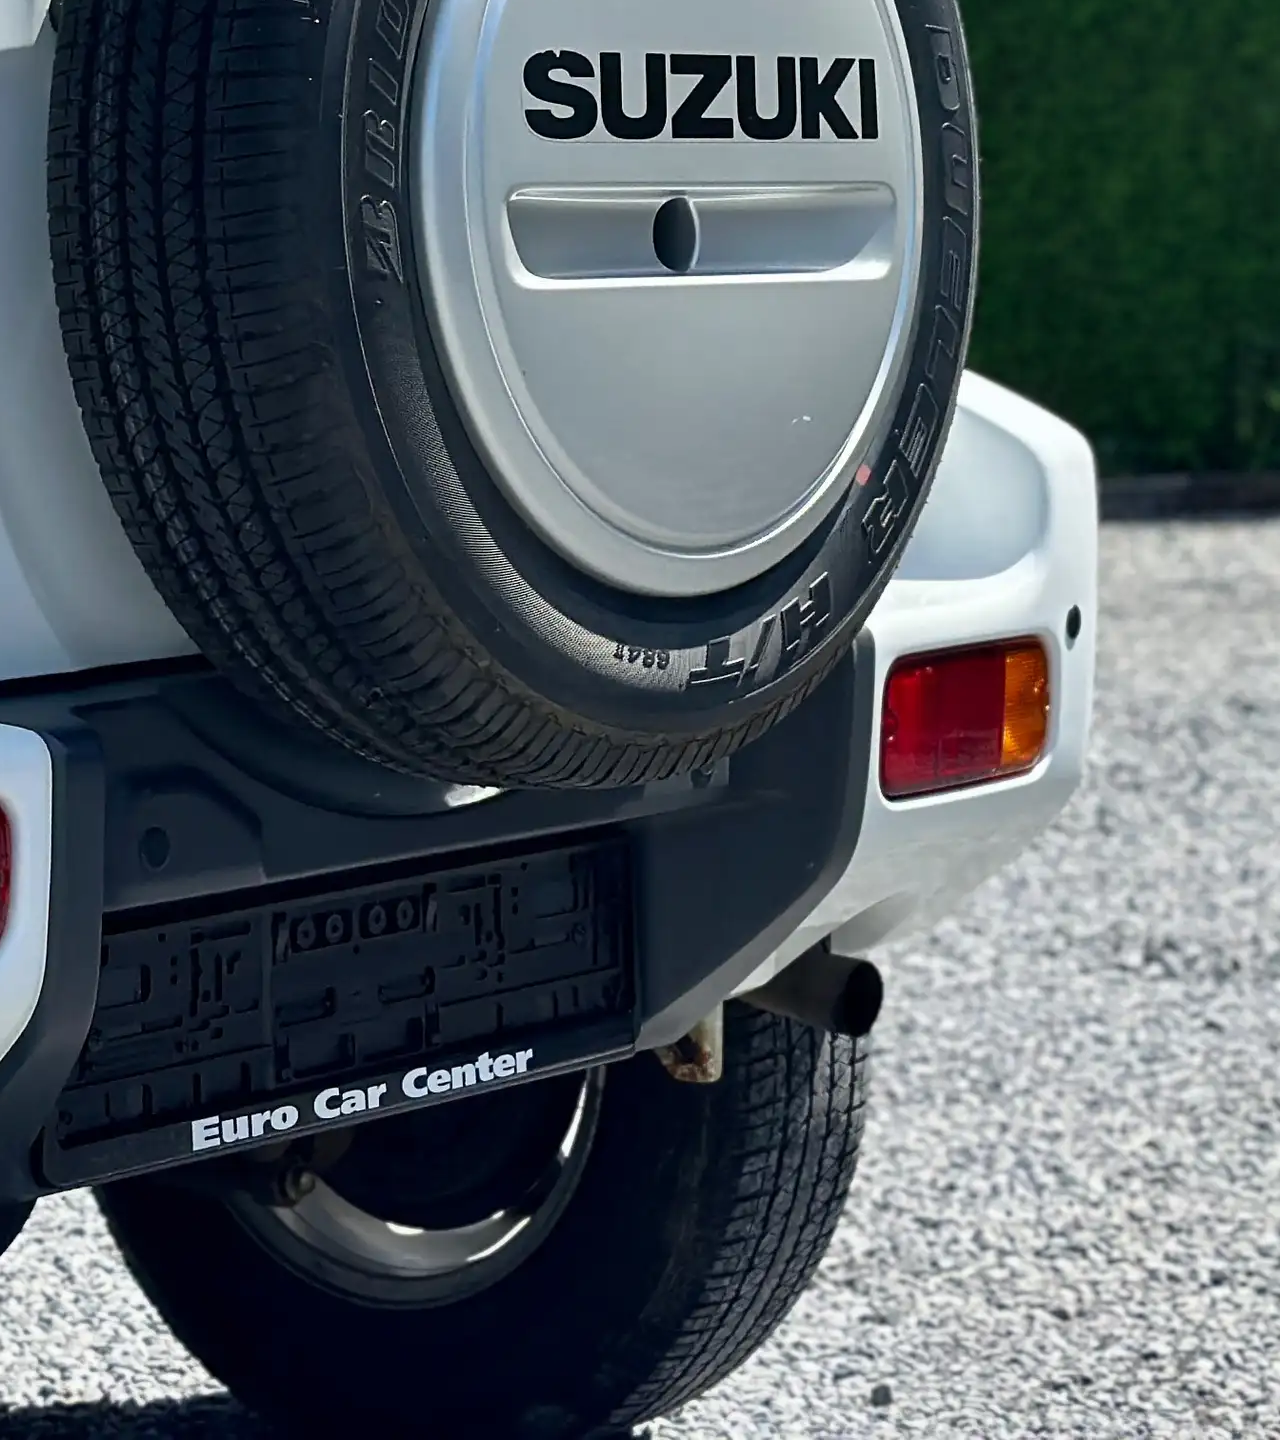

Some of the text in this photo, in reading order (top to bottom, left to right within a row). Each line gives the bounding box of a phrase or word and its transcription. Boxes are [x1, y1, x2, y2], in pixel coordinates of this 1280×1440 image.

[522, 49, 878, 140] SUZUKI
[861, 24, 972, 554] DUELER
[686, 571, 832, 689] H/T
[191, 1047, 533, 1152] Euro Car Center
